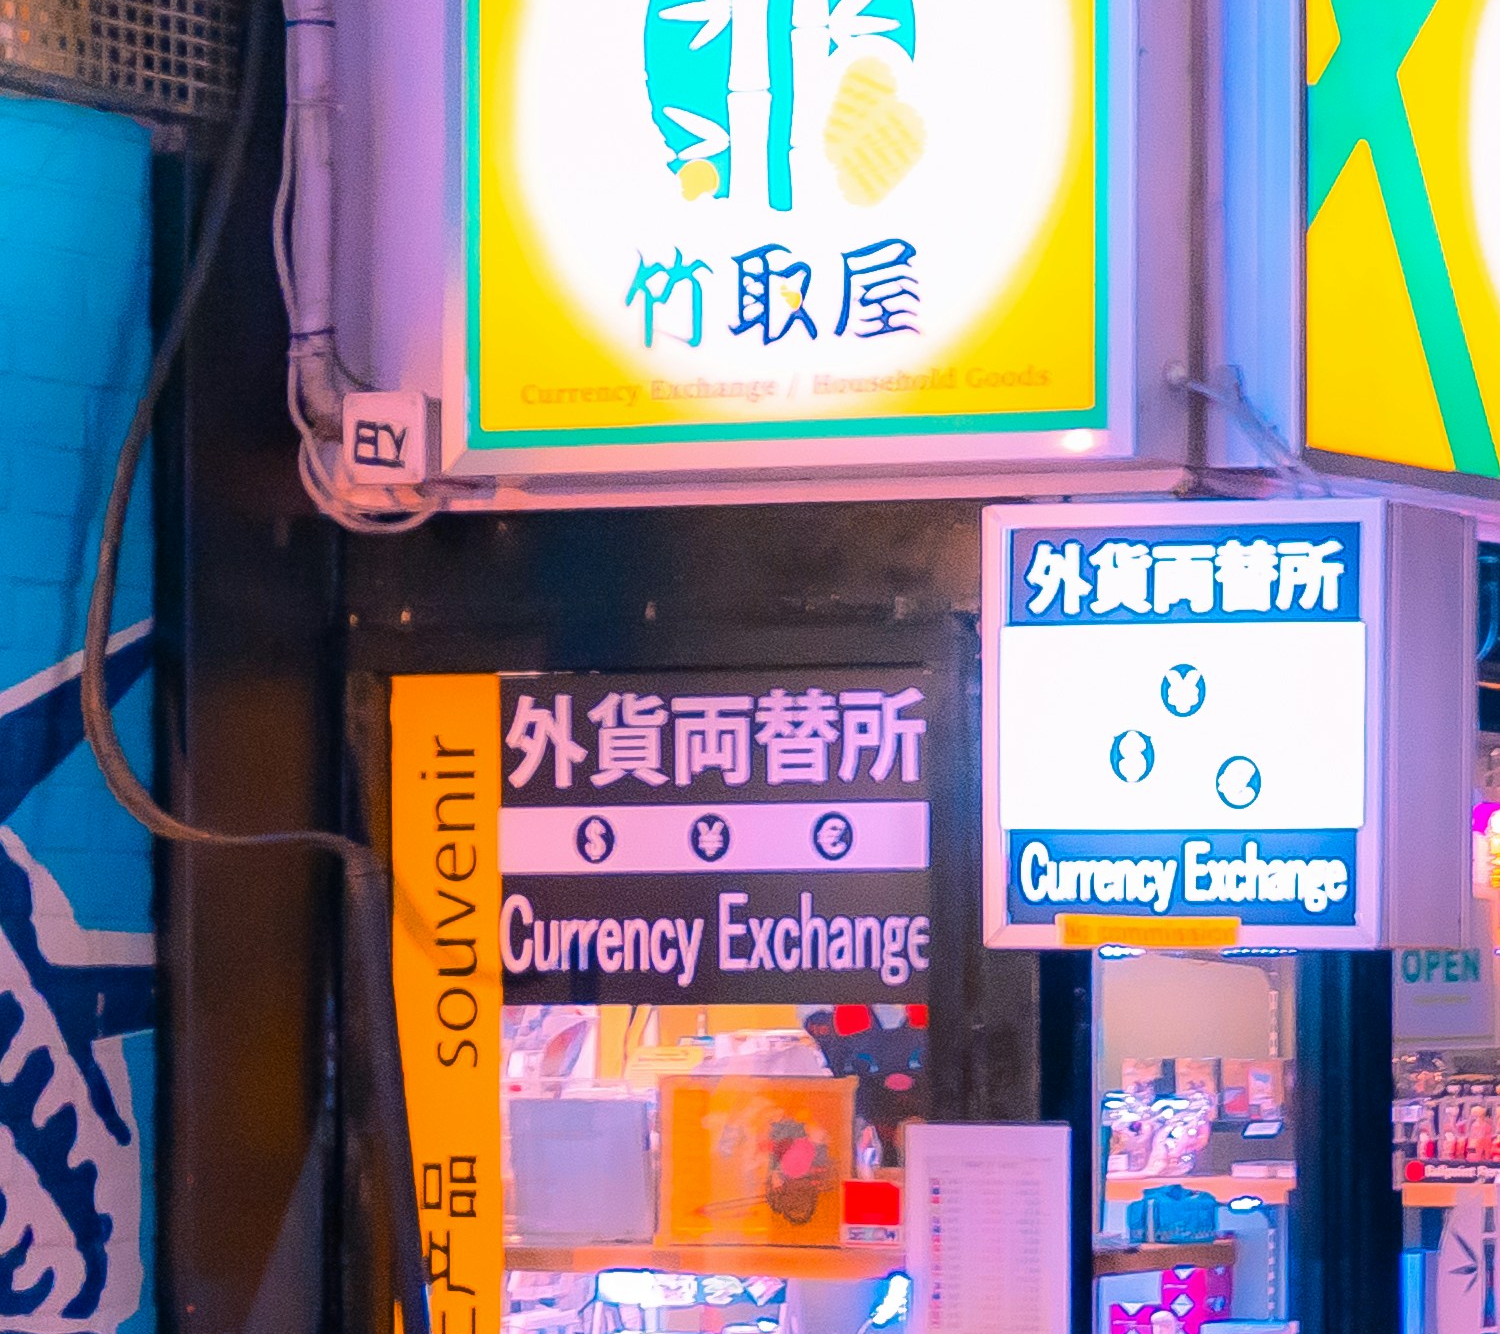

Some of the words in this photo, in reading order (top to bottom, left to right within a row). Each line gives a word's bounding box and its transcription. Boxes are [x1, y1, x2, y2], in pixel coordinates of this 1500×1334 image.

[624, 238, 923, 349] 竹取屋
[521, 382, 640, 407] Currency
[650, 377, 777, 403] Exchange
[813, 367, 957, 396] Household
[966, 365, 1052, 390] Goods
[1026, 539, 1344, 616] 外貨両替所
[505, 686, 928, 789] 外貨両替所
[419, 733, 479, 1069] souvenir
[1021, 840, 1177, 912] Currency
[1184, 840, 1348, 912] Exchange
[500, 893, 704, 987] Currency
[718, 892, 930, 986] Exchange
[1402, 949, 1481, 985] OPEN
